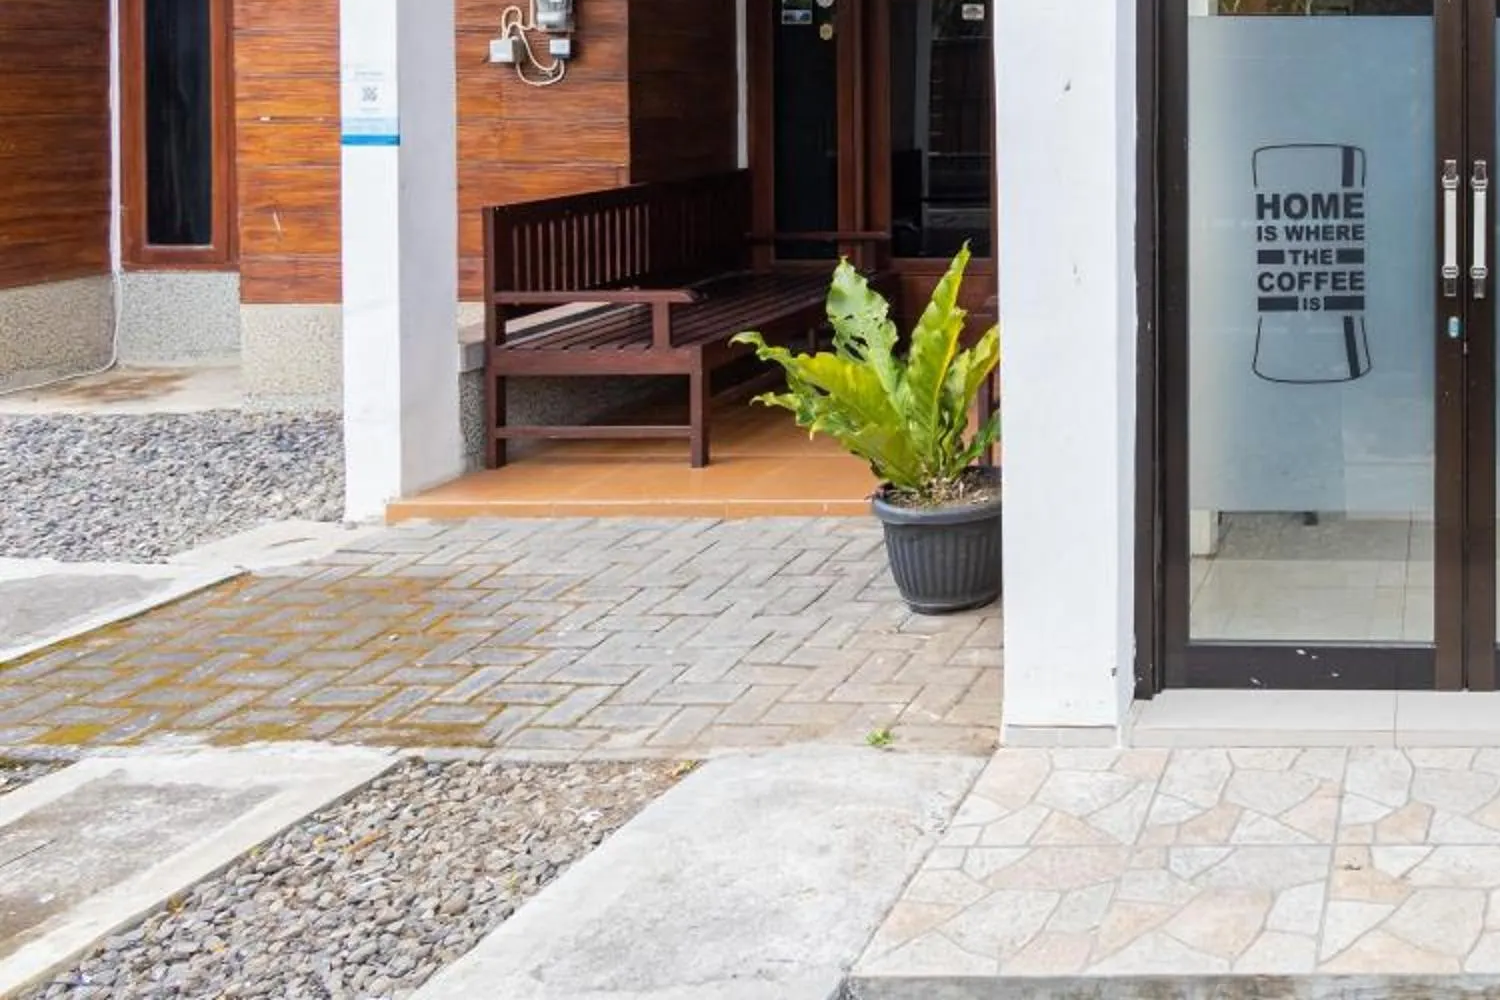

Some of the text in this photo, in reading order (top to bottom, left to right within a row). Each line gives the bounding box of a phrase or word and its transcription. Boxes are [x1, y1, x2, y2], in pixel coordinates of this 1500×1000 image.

[1256, 192, 1365, 221] HOME
[1257, 225, 1365, 243] IS WHERE
[1289, 249, 1333, 266] THE
[1257, 271, 1365, 293] COFFEE
[1302, 297, 1321, 312] IS
